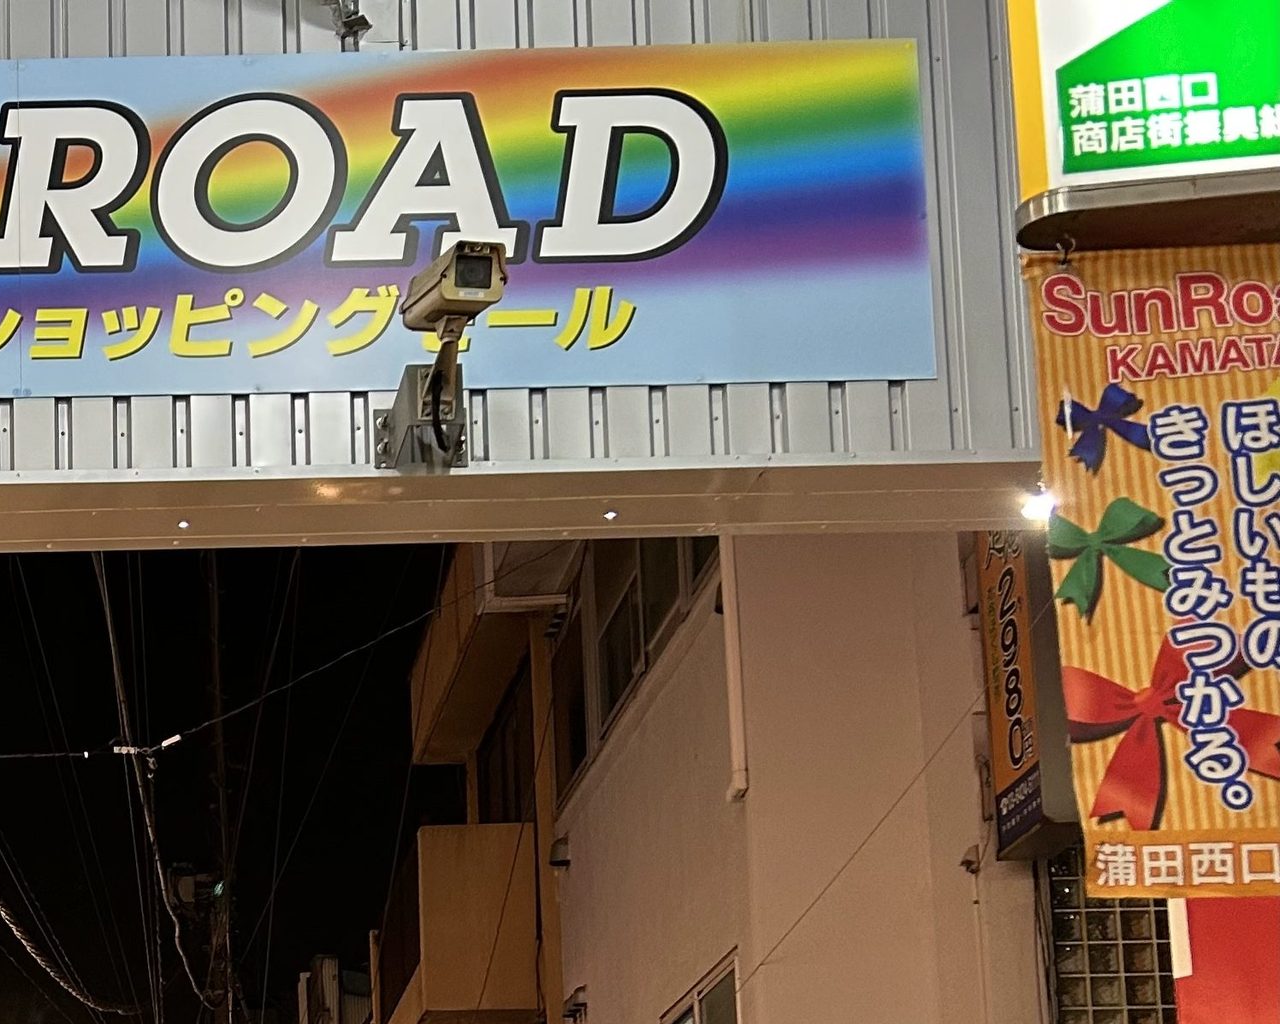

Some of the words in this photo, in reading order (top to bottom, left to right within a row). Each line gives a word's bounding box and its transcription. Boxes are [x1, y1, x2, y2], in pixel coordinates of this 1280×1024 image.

[1068, 72, 1219, 118] 蒲田西口
[1150, 404, 1252, 811] きっとみつかる。
[1095, 842, 1280, 887] 蒲田西口
